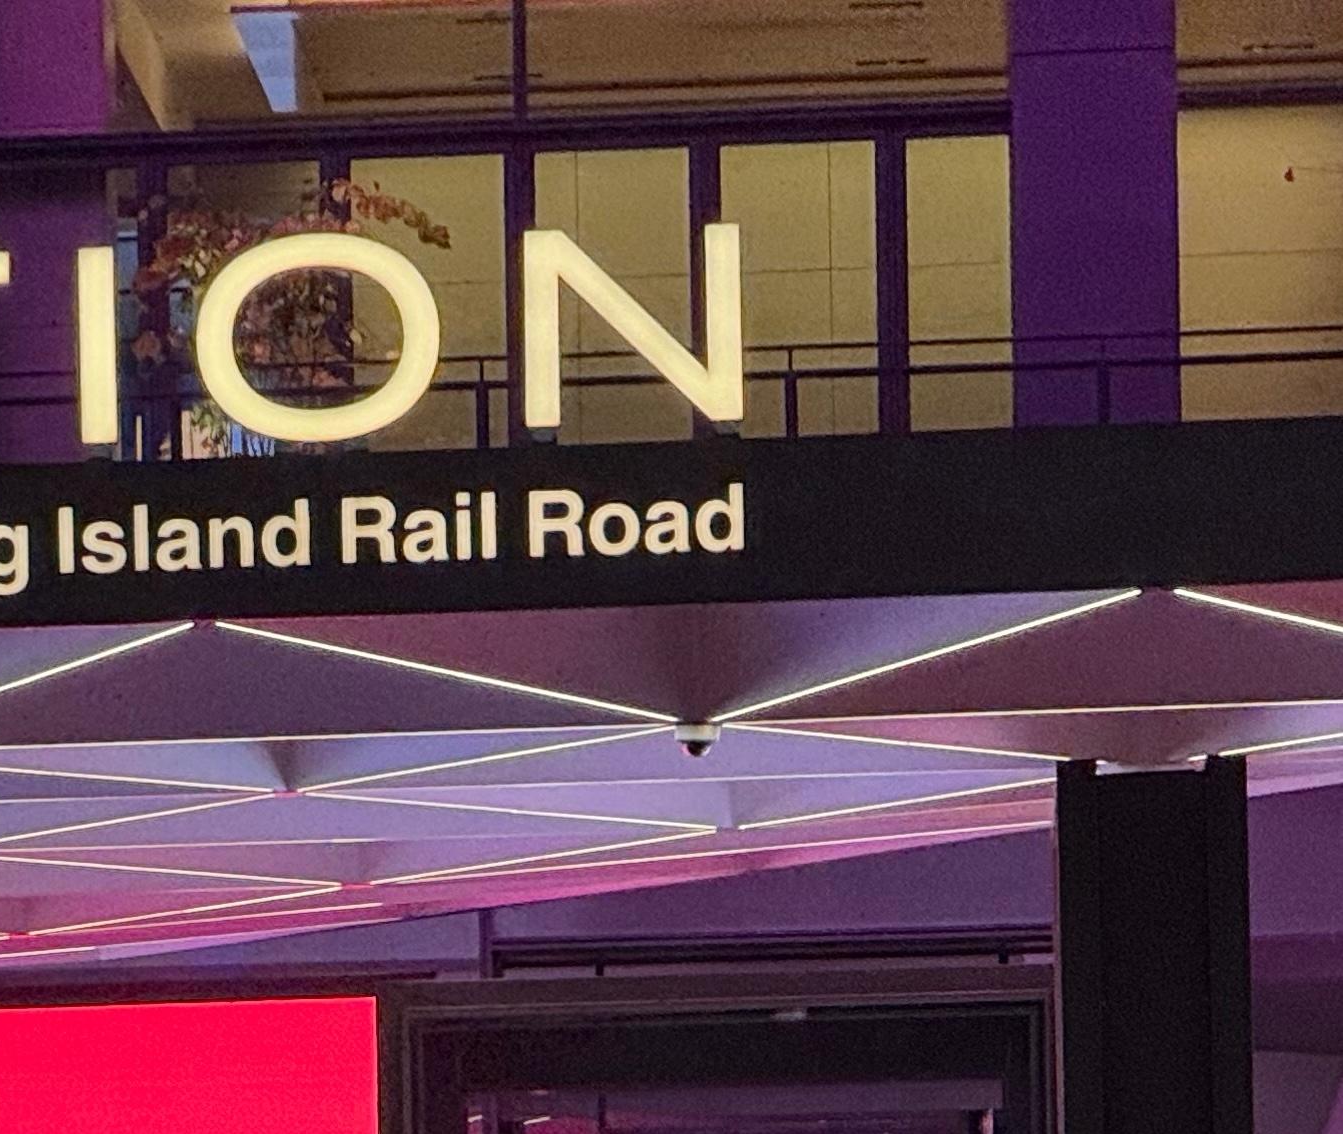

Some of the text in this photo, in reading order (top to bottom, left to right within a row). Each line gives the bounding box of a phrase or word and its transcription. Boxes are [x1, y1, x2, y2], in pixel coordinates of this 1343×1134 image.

[56, 497, 312, 575] Island
[340, 490, 498, 565] Rail
[527, 481, 746, 559] Road
